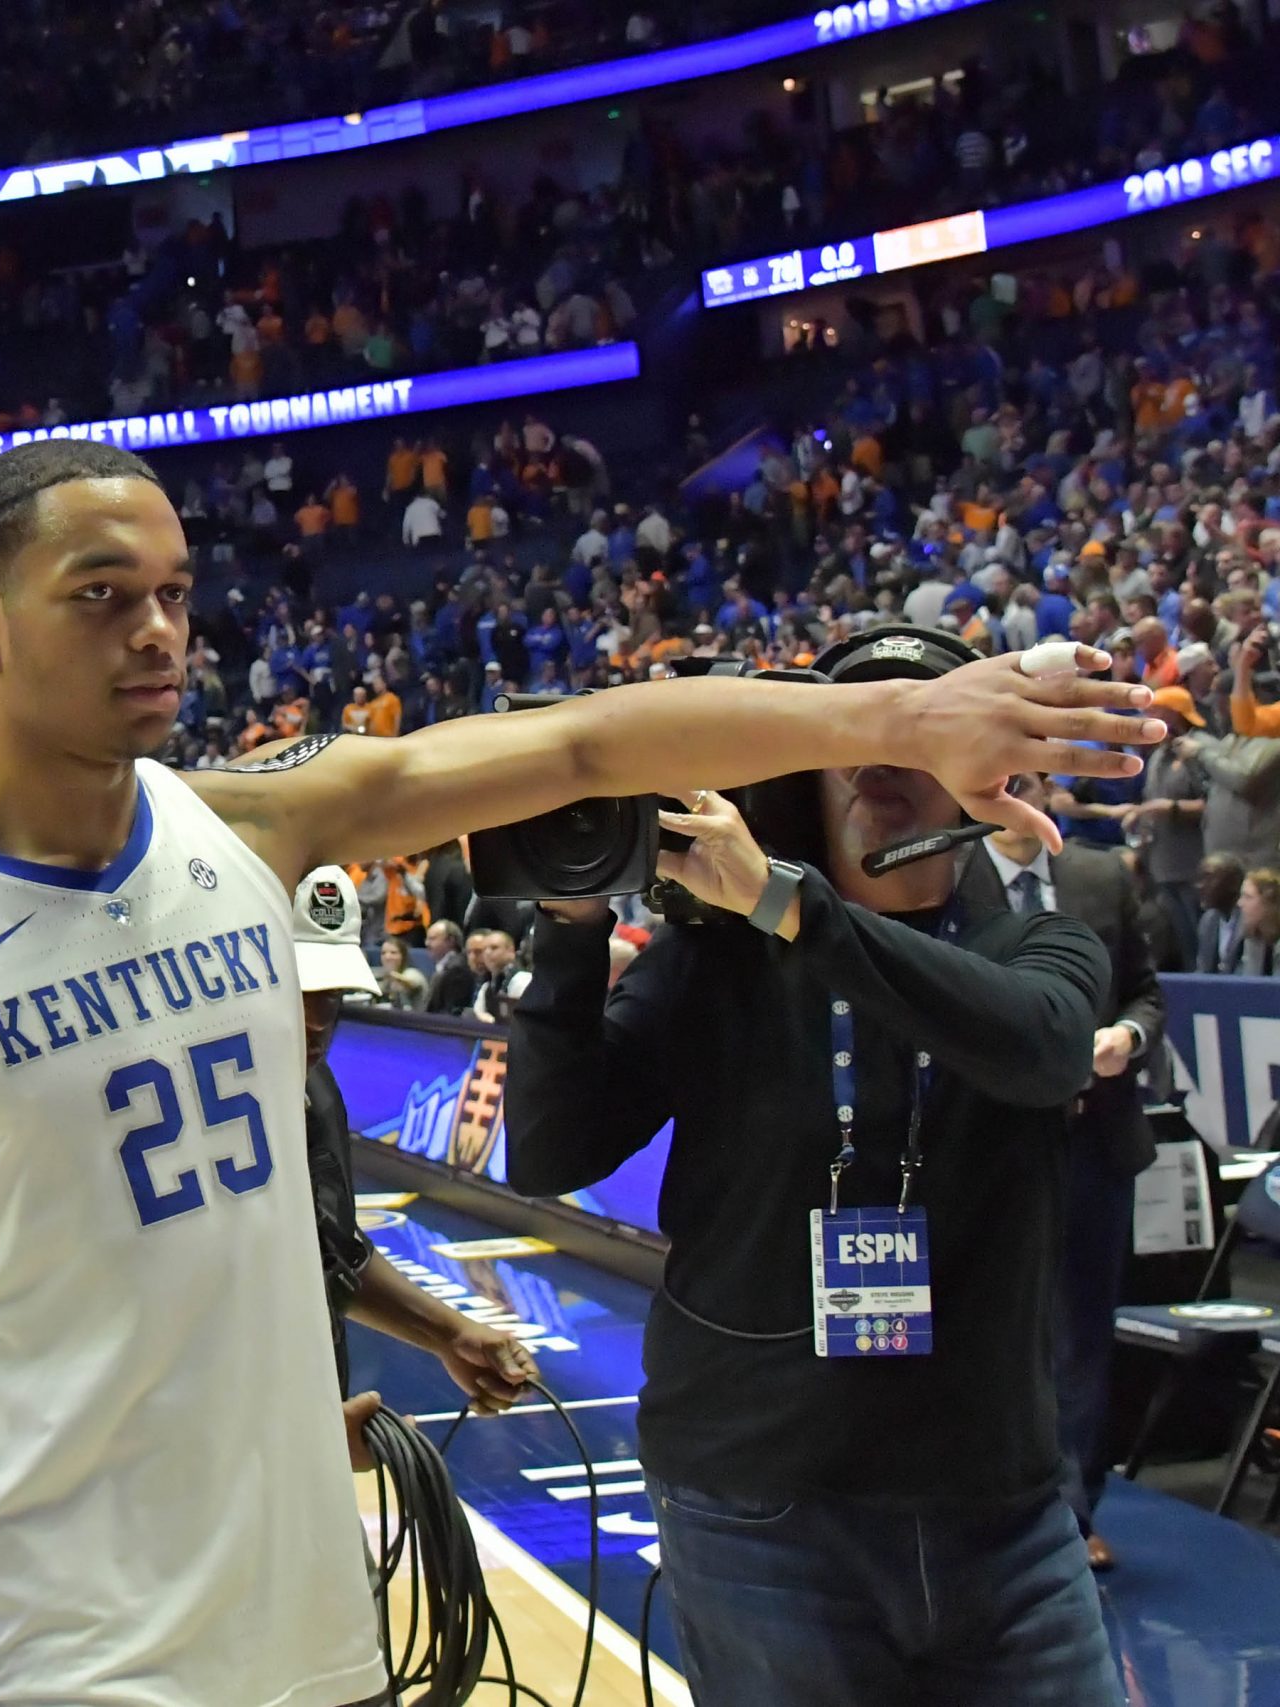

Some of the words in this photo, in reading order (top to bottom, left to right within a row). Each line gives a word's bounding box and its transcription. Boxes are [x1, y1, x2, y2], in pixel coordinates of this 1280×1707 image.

[813, 0, 889, 44] 2019
[1123, 158, 1204, 212] 2019
[1210, 139, 1273, 188] SEC
[209, 379, 413, 436] TOURNAMENT
[878, 837, 942, 867] BOSE
[104, 1031, 274, 1227] 25
[838, 1232, 918, 1265] ESPN
